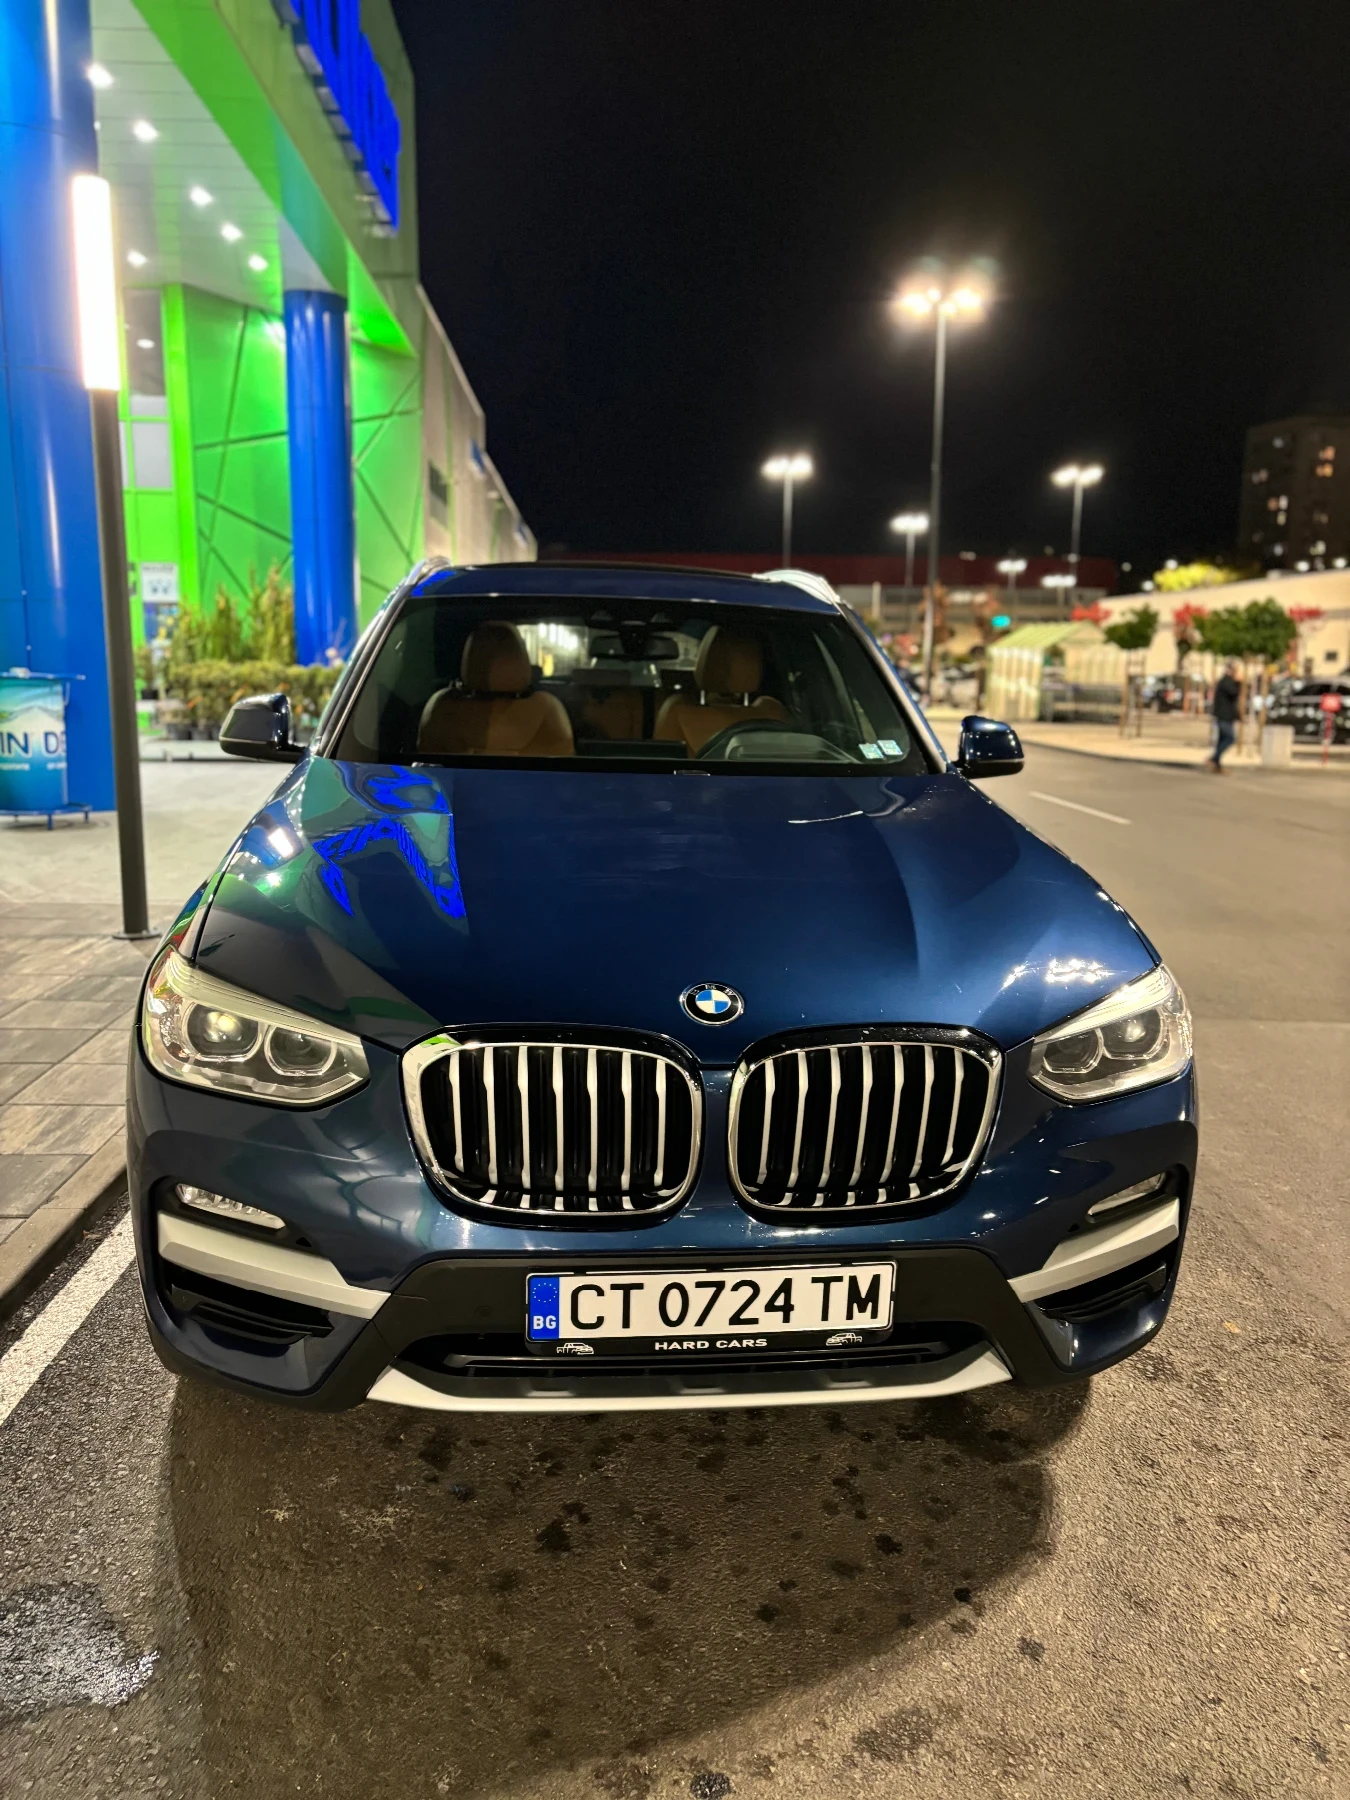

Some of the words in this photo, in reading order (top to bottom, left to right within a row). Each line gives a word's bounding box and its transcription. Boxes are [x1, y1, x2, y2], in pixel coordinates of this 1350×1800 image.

[570, 1282, 645, 1330] CT
[658, 1277, 795, 1328] 0724
[810, 1273, 881, 1322] TM
[533, 1315, 557, 1330] BG
[654, 1340, 709, 1351] HARD
[715, 1338, 768, 1349] CARS
